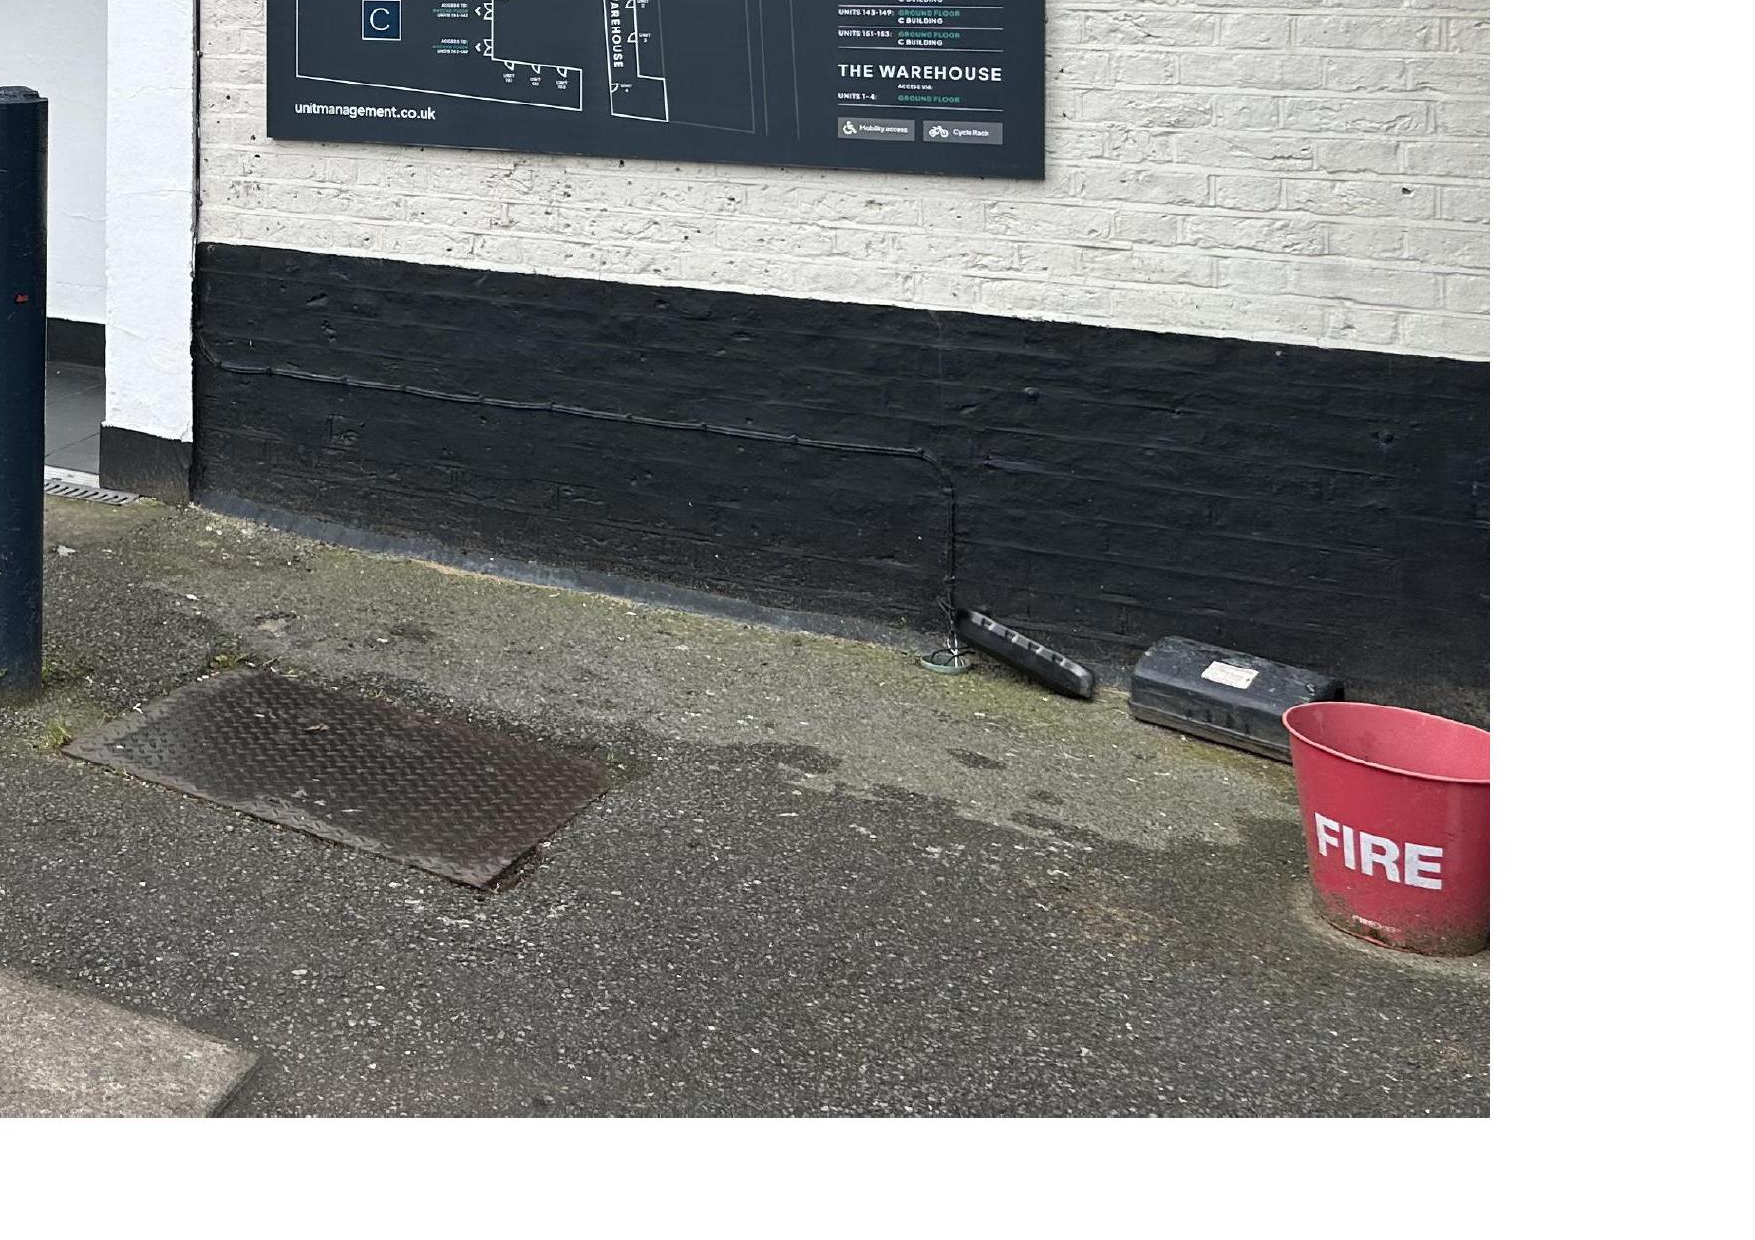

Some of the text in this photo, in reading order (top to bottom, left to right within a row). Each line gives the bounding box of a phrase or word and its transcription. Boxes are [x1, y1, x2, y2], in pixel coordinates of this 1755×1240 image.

[369, 7, 391, 31] C
[838, 64, 1002, 82] THE WAREHOUSE
[898, 94, 933, 102] GROUND
[294, 102, 436, 120] unitmanagement.co.uk
[859, 125, 885, 133] Mobility
[953, 128, 973, 137] Cycle
[1314, 812, 1443, 891] FIRE
